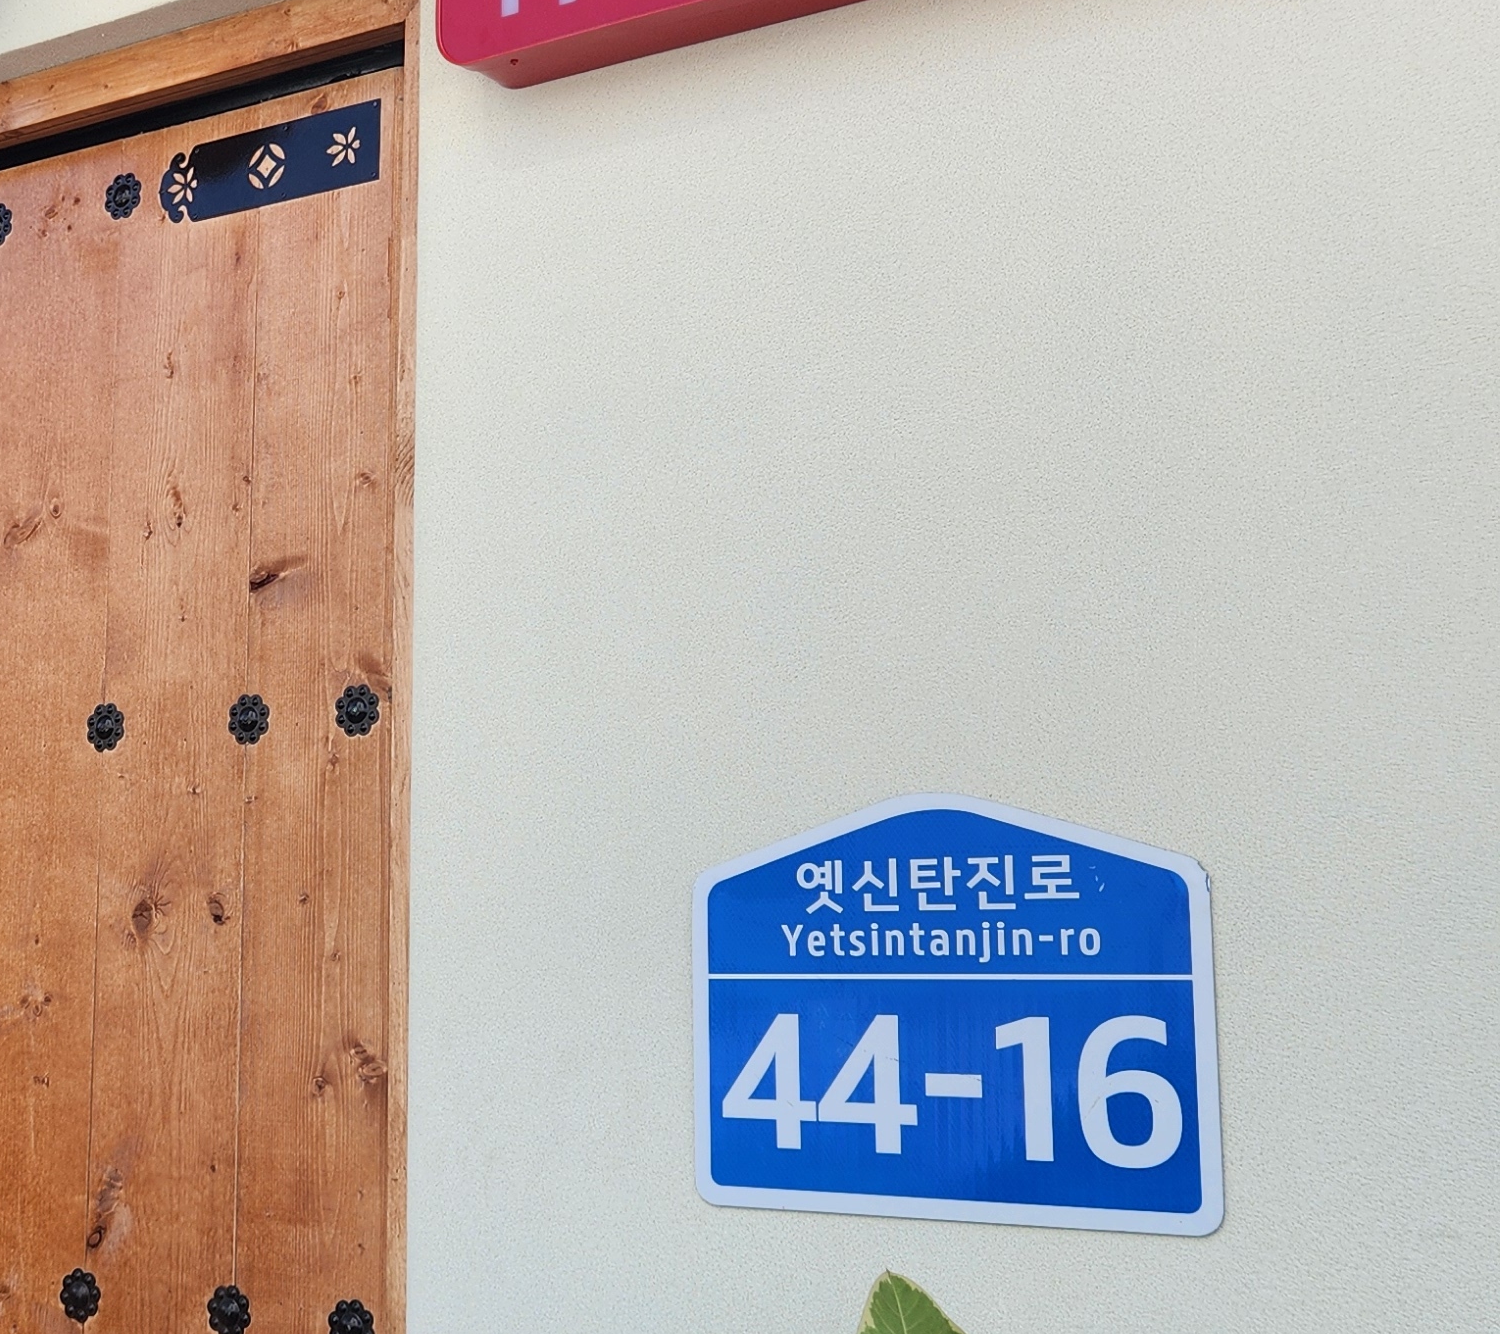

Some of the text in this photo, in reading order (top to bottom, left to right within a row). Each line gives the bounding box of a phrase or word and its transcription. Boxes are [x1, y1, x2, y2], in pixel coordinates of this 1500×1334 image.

[795, 853, 1081, 915] 옛신탄진로
[781, 920, 1102, 964] Yetsintanjin-ro
[721, 1012, 1184, 1170] 44-16
